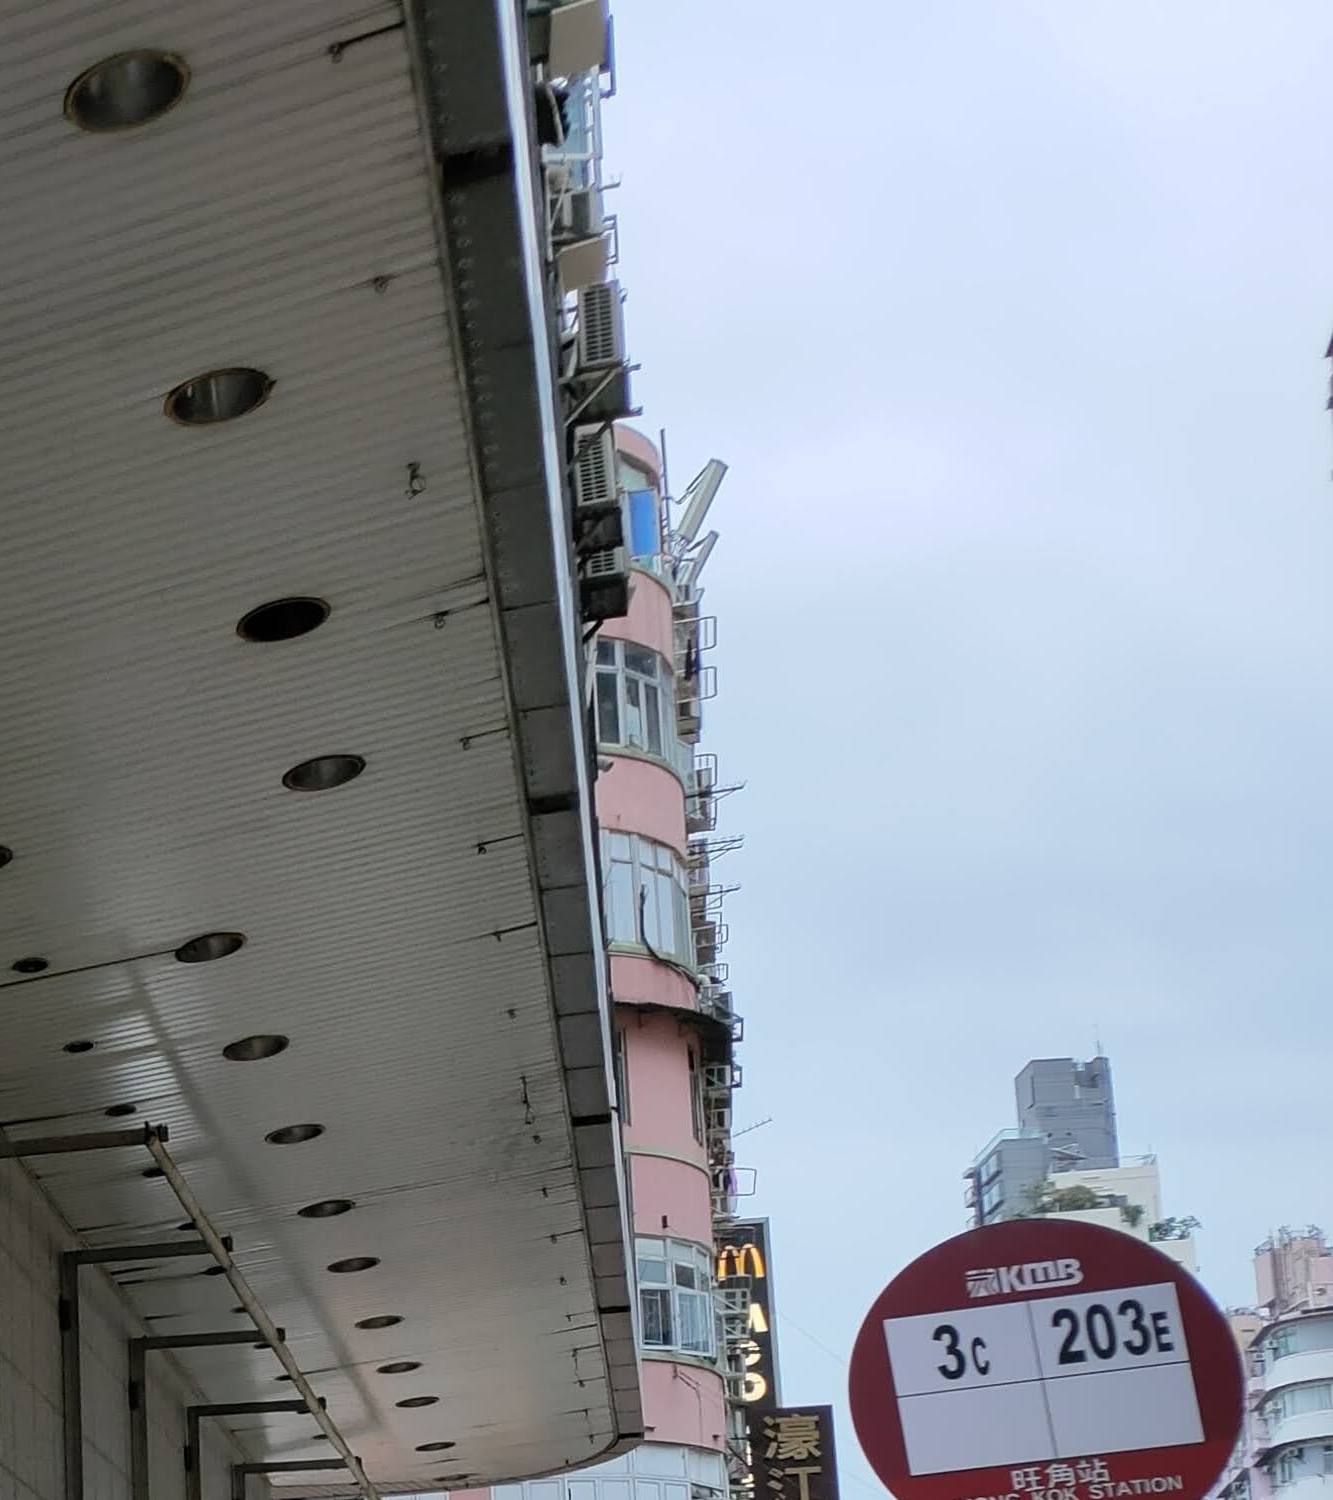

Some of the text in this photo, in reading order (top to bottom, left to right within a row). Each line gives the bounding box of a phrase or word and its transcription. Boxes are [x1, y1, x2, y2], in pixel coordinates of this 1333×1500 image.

[932, 1323, 990, 1381] 3C
[1051, 1298, 1175, 1366] 203E
[1010, 1458, 1110, 1493] 旺角站
[1090, 1475, 1184, 1500] STATION
